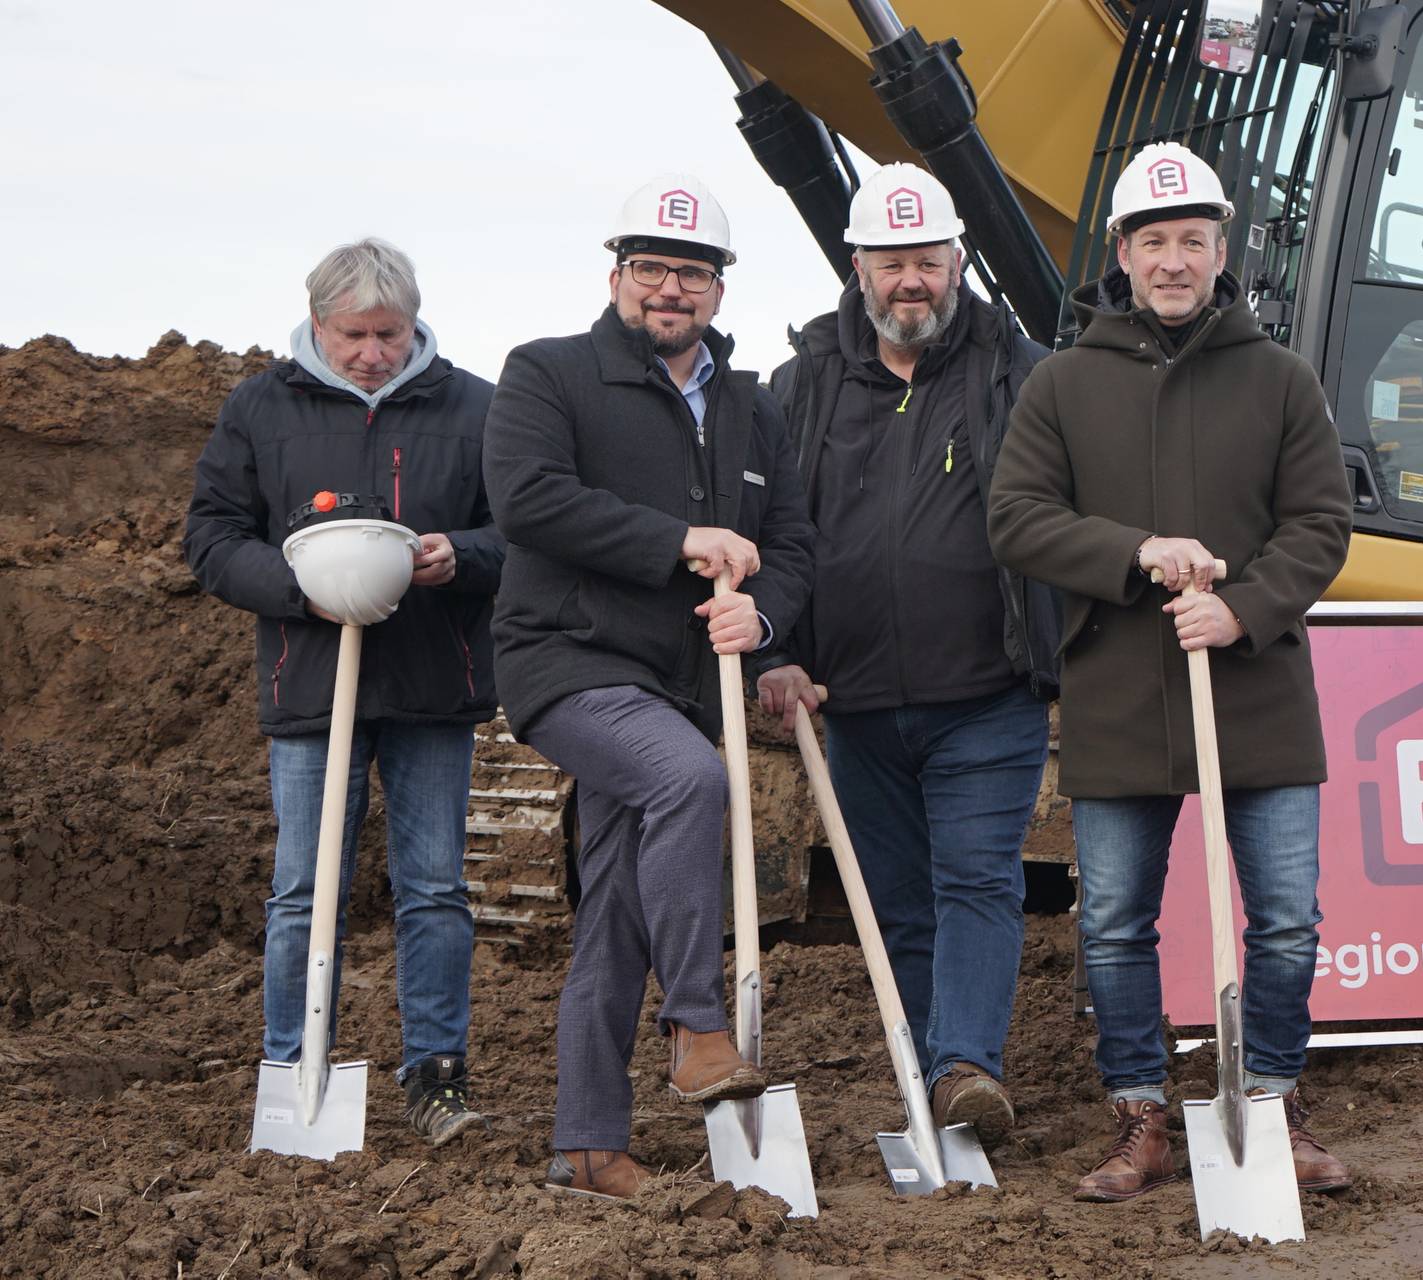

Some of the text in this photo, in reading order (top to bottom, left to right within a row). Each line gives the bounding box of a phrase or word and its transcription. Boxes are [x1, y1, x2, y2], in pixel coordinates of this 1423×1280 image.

[1157, 166, 1178, 188] E
[669, 198, 689, 220] E
[895, 197, 915, 220] E
